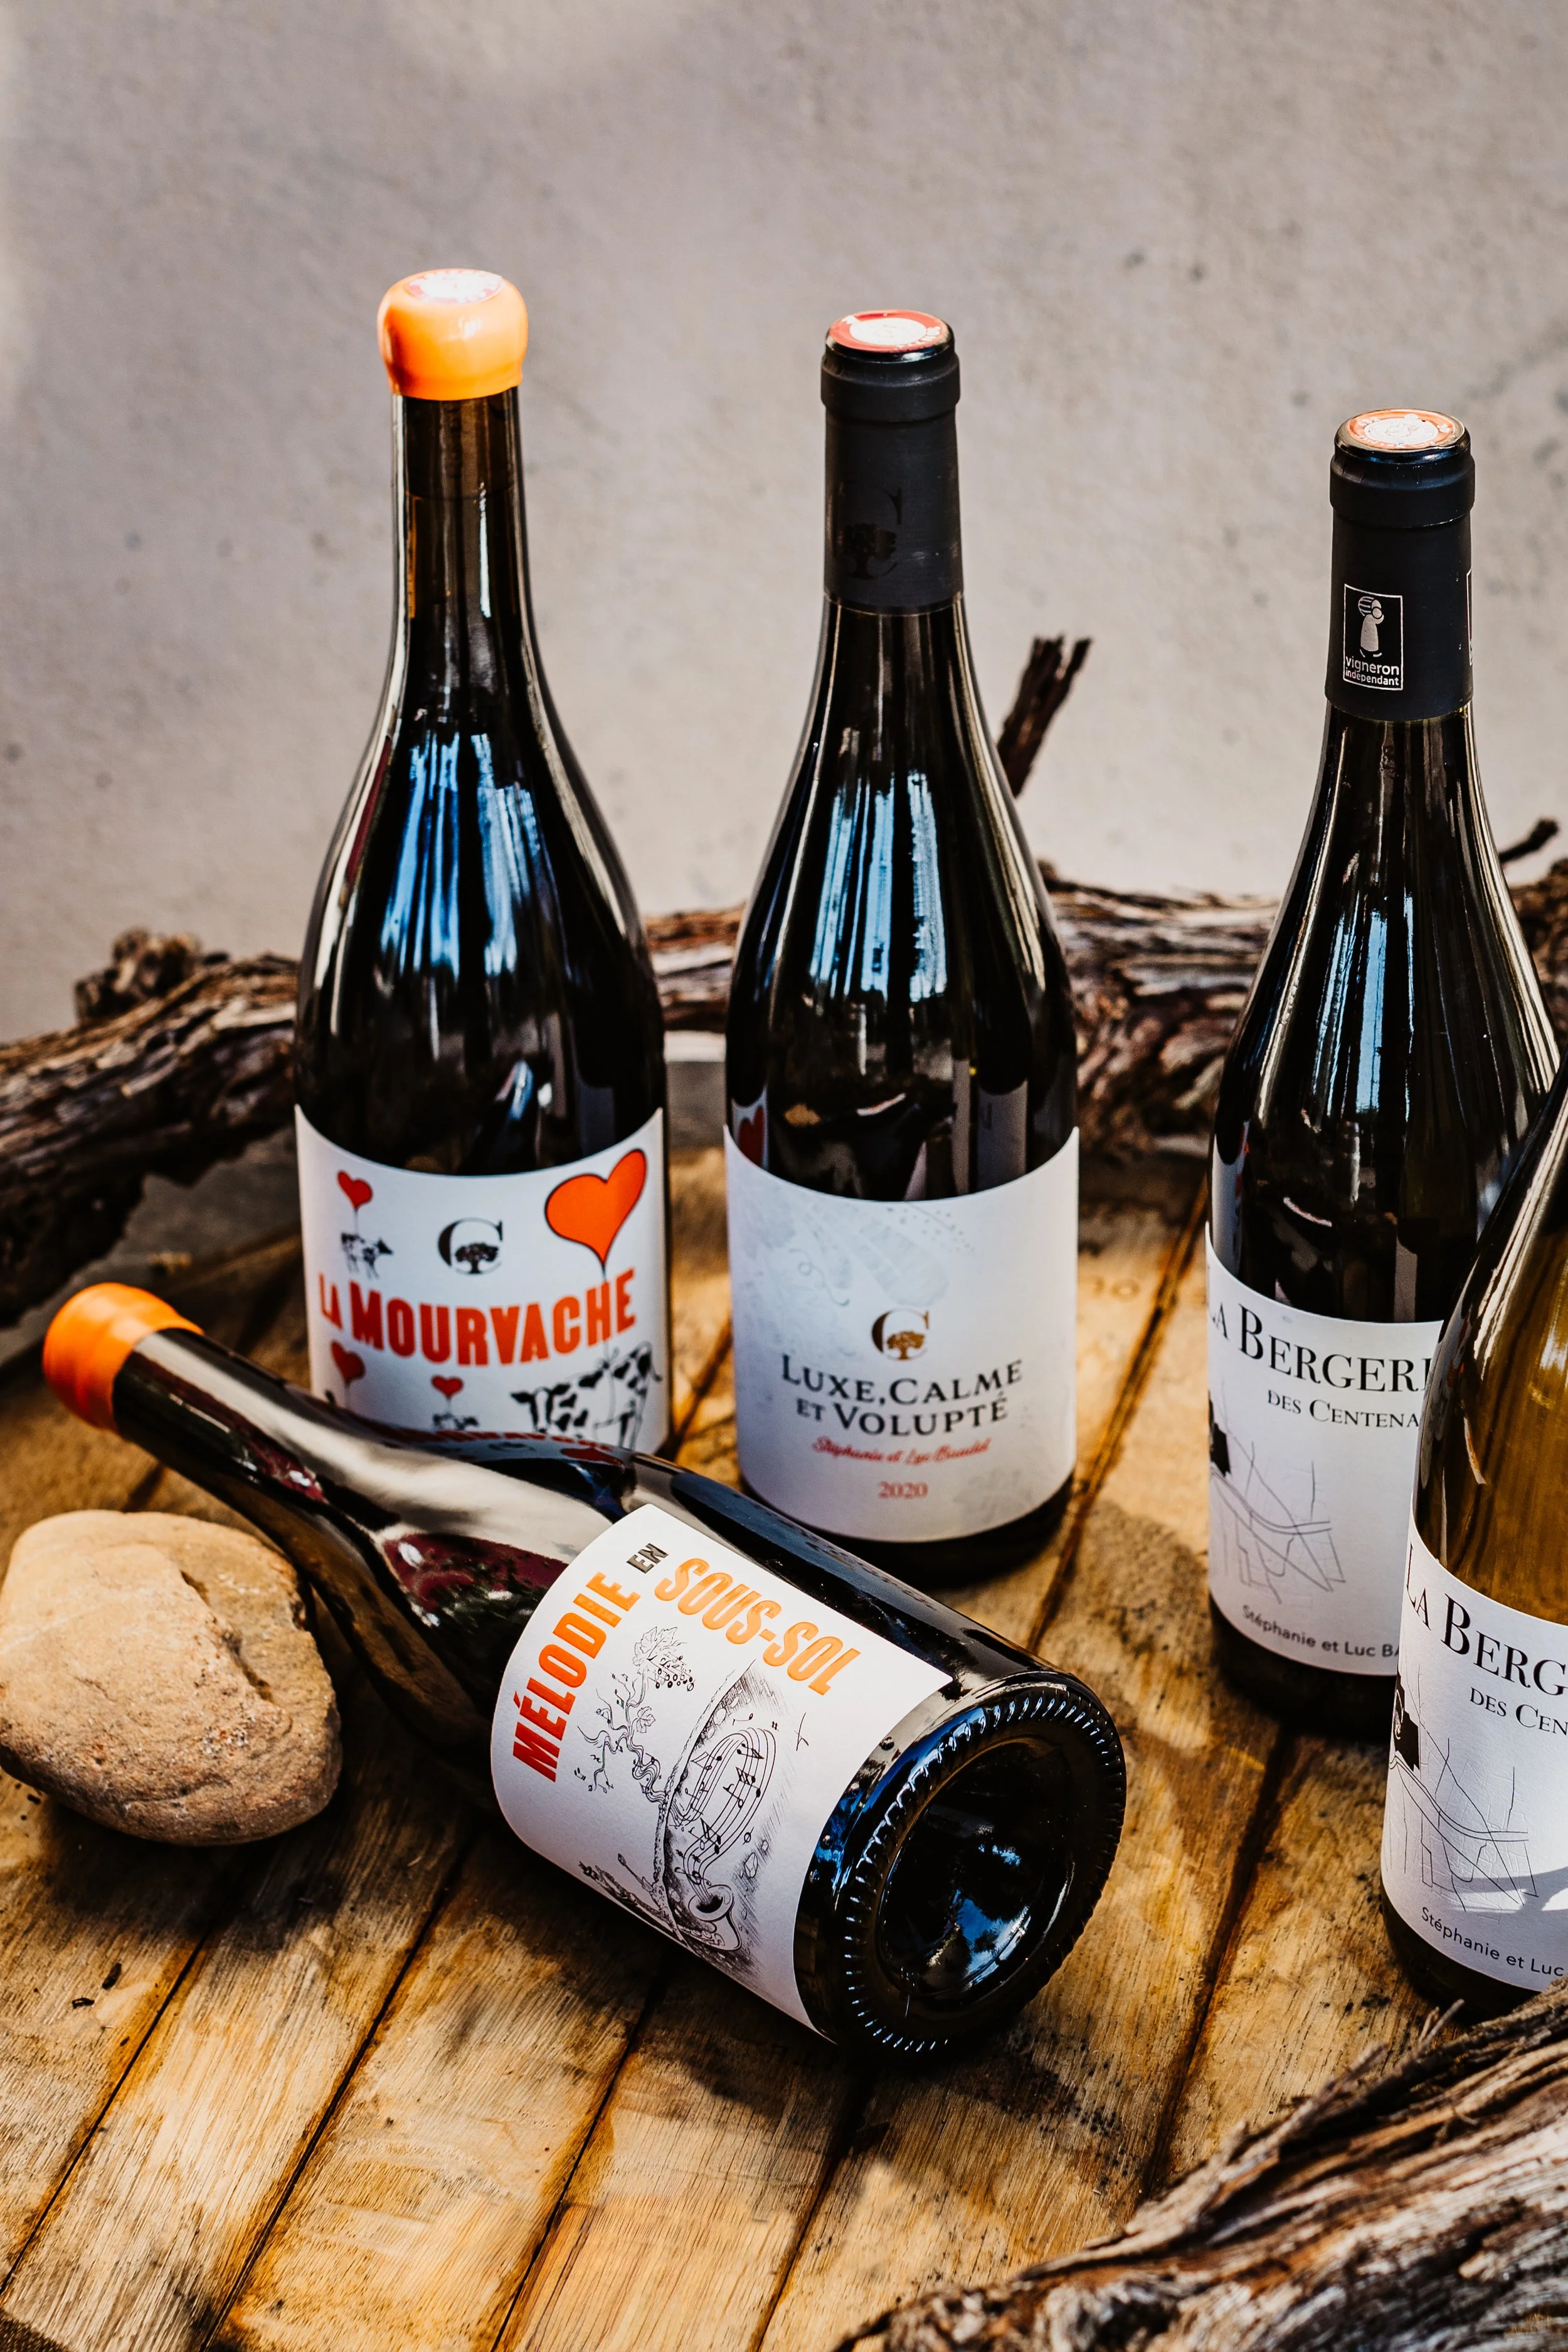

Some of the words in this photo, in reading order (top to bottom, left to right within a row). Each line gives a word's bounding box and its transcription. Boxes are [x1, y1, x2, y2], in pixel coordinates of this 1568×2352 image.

[1345, 655, 1400, 675] vigneron
[1345, 667, 1399, 686] independant
[319, 1272, 342, 1332] LA
[348, 1266, 637, 1366] MOURVACHE
[781, 1353, 886, 1406] LUXE,
[889, 1359, 1024, 1406] CALME
[796, 1397, 826, 1422] ET
[833, 1390, 1008, 1436] VOLUPTÉ
[1267, 1389, 1302, 1414] DES
[1308, 1399, 1420, 1428] CENTENA
[879, 1481, 930, 1500] 2020
[1242, 1603, 1316, 1648] Stéphanie
[1322, 1640, 1340, 1653] et
[1343, 1641, 1376, 1657] Luc
[1406, 1542, 1433, 1631] LA
[1441, 1592, 1568, 1696] BERG
[511, 1570, 643, 1784] MÉLODIE
[625, 1542, 672, 1575] EN
[653, 1556, 862, 1697] SOUS-SOL
[1469, 1687, 1507, 1717] DES
[1515, 1703, 1568, 1737] CEN
[1421, 1907, 1500, 1960] Stéphanie
[1505, 1954, 1525, 1969] et
[1530, 1958, 1565, 1977] Luc
